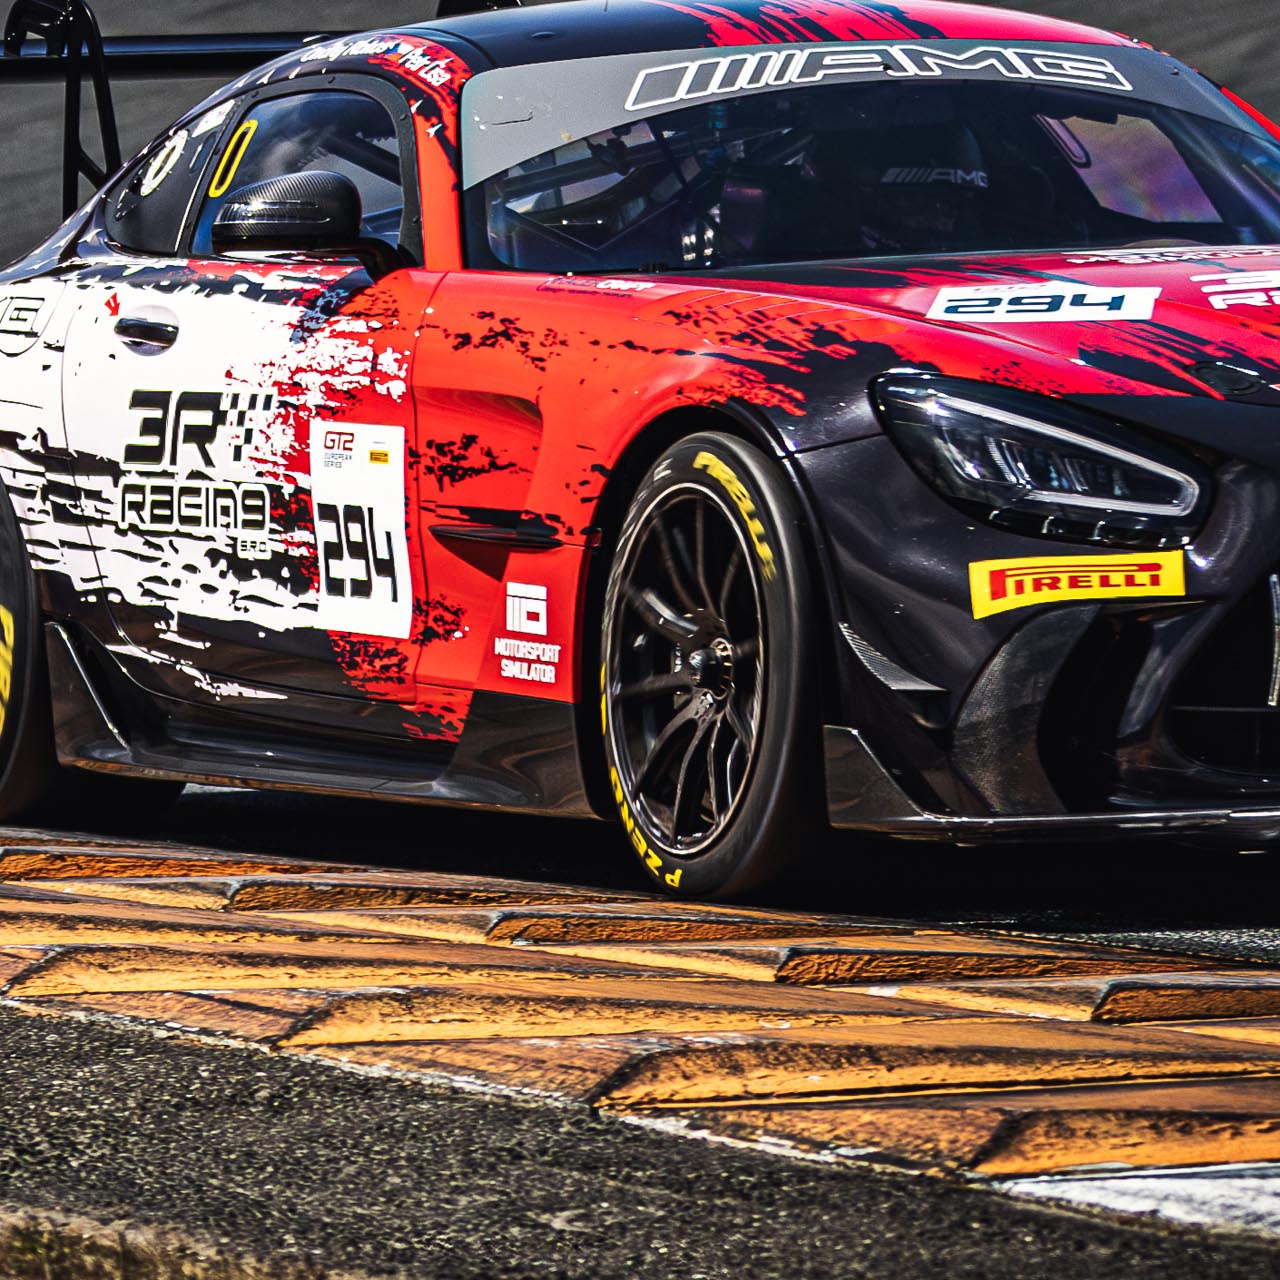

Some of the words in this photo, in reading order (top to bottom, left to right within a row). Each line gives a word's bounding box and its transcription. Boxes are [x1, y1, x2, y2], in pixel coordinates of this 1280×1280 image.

[943, 293, 1126, 314] 294
[324, 430, 355, 452] GT2
[317, 502, 398, 603] 294
[989, 562, 1163, 601] PIRELLI
[494, 636, 562, 663] MOTORSPORT
[500, 658, 556, 684] SIMULATOR
